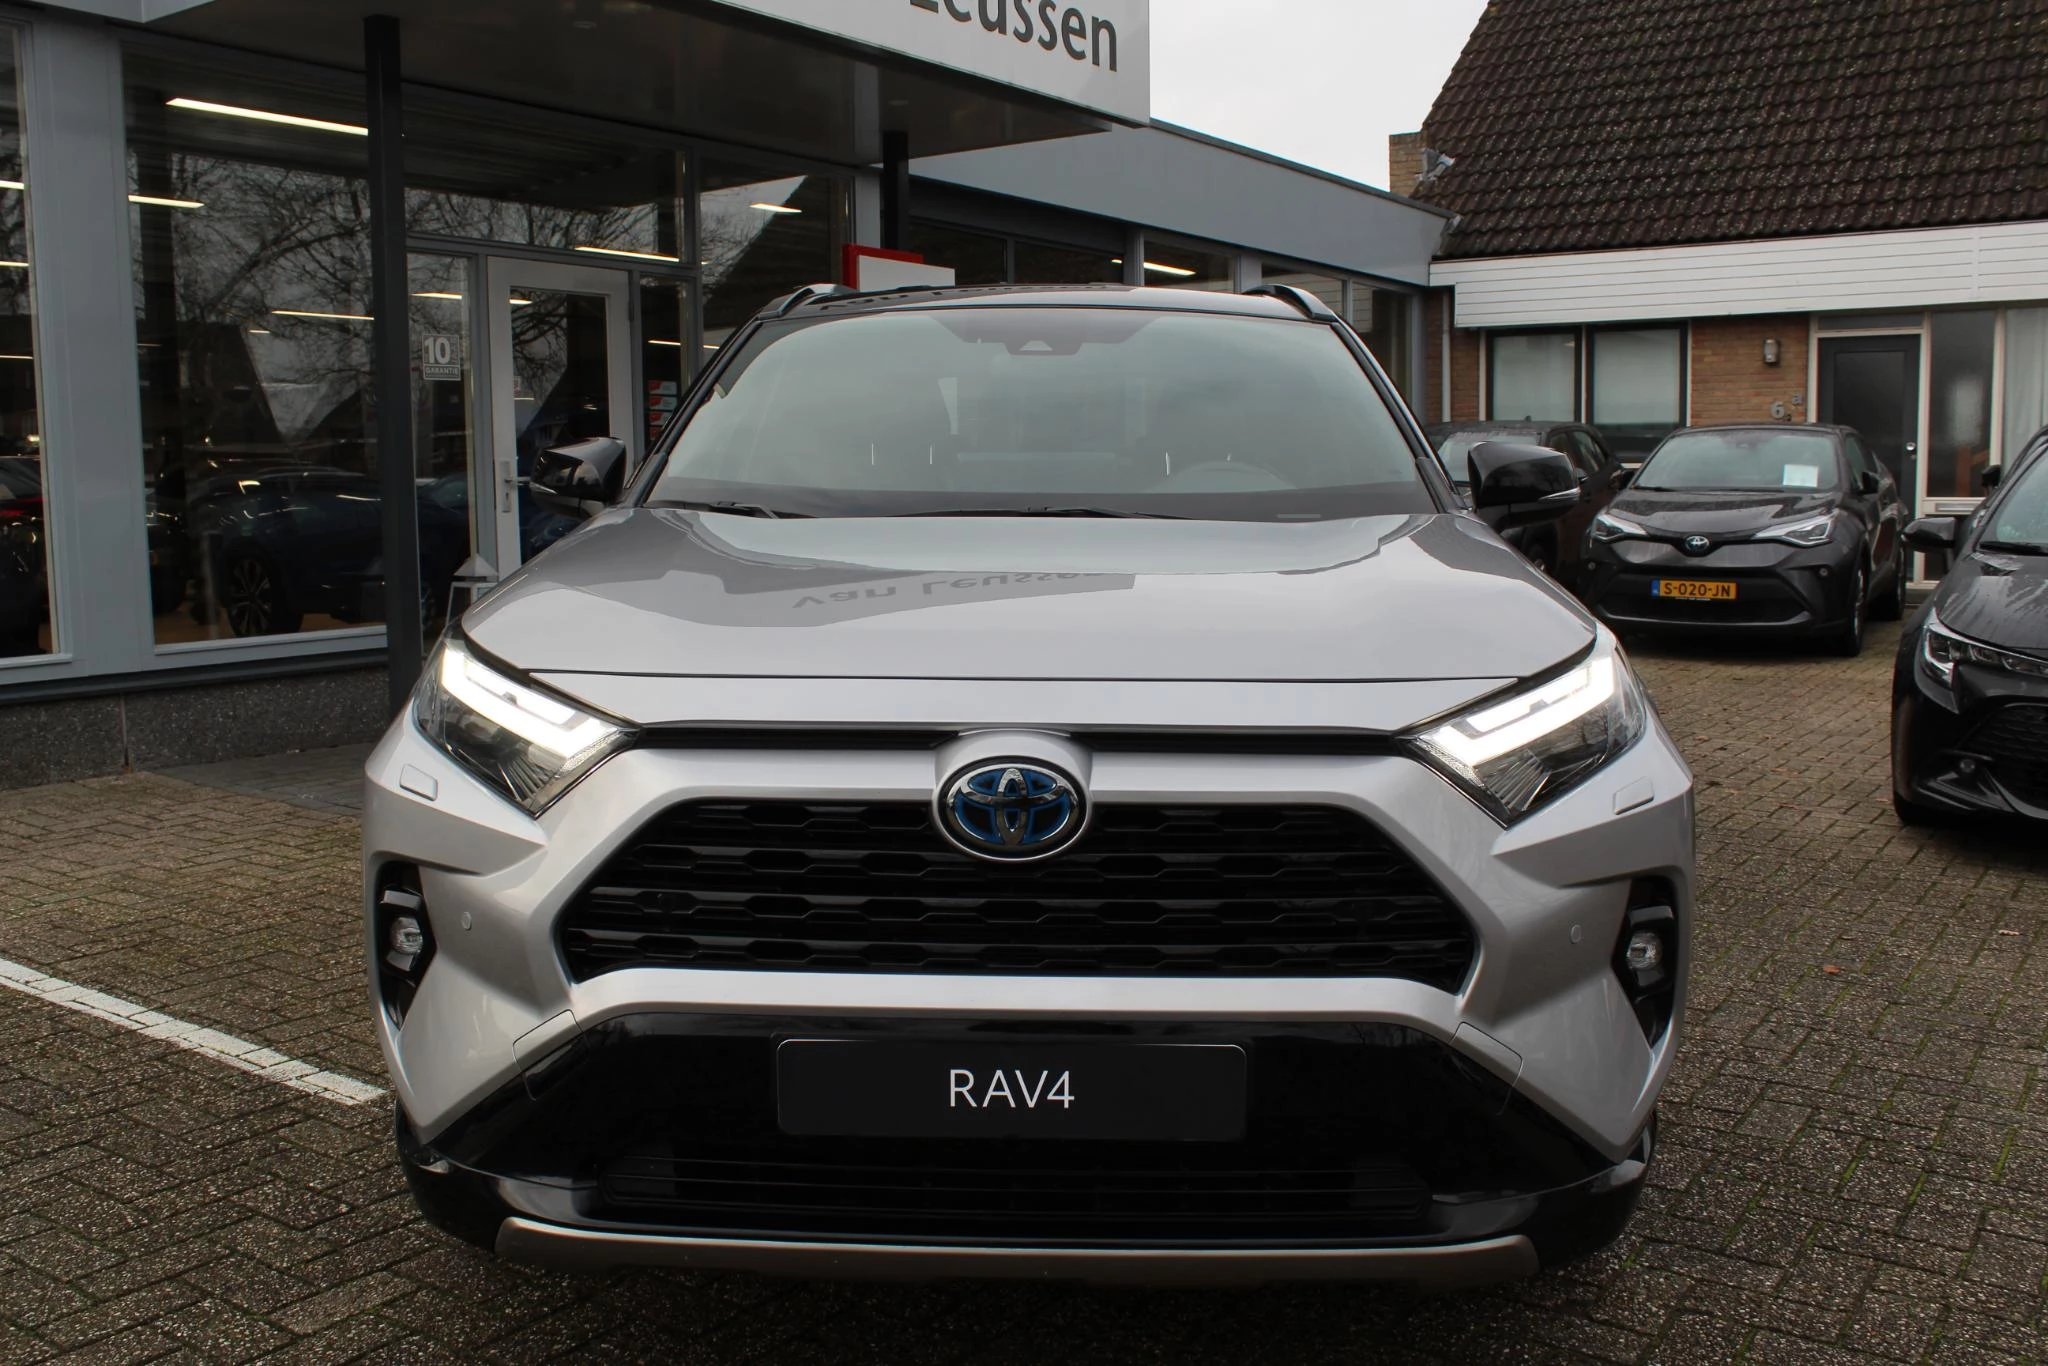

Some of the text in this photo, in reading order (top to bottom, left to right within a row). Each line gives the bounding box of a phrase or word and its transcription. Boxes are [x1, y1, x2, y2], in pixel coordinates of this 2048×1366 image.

[910, 0, 1117, 72] ussen
[424, 337, 450, 364] 10
[425, 367, 459, 375] GARANTIE
[1771, 401, 1784, 419] 6
[1663, 582, 1731, 597] S-020-JN
[950, 1069, 1075, 1109] RAV4
